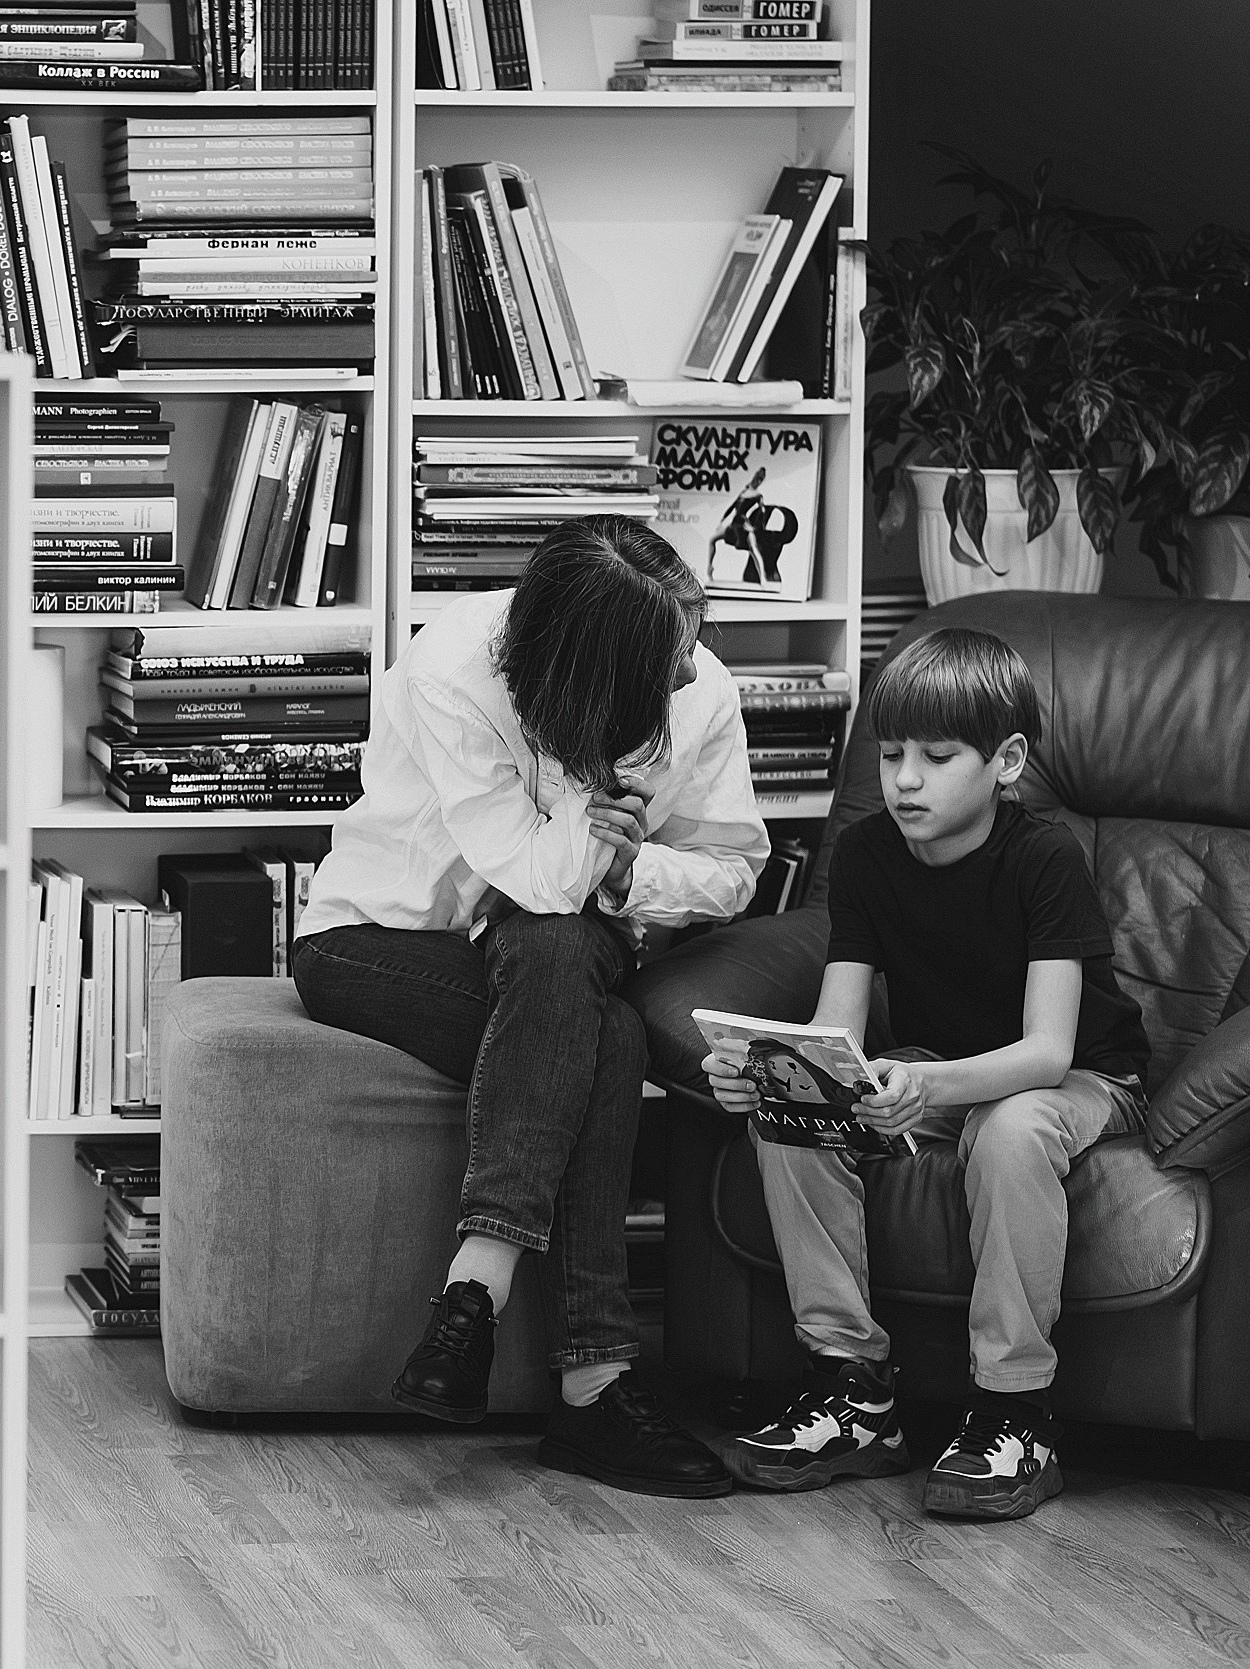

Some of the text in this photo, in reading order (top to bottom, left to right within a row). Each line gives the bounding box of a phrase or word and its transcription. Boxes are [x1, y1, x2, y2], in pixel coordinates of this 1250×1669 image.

[759, 2, 811, 19] ГОМЕР
[10, 23, 97, 35] ЭНЦИКЛОПЕДИЯ
[751, 25, 800, 37] ГОМЕР
[38, 65, 160, 79] Коллаж в России
[18, 246, 32, 292] ПРОМЫСЛЫ
[281, 257, 365, 270] КОНЕНКОВ
[2, 277, 18, 322] DIALOG
[118, 306, 355, 319] ГОСУДАРСТВЕННЫЙ ЭРМИТАЖ
[25, 292, 45, 366] ХУДОЖЕСТВЕННЫЕ
[32, 406, 118, 417] MANN Photographien
[657, 423, 813, 455] СКУЛЬПТУРА
[655, 446, 749, 471] МАЛЫХ
[321, 452, 338, 511] АНТИКВАРИАТ
[656, 468, 730, 492] ФОРМ
[65, 509, 120, 519] творчестве.
[55, 539, 63, 547] и
[64, 539, 120, 550] творчестве.
[97, 576, 176, 586] виктор калинин
[65, 595, 126, 611] БЕЛКИН
[140, 655, 305, 669] СОЮЗ ИСКУССТВА И ТРУДА
[166, 668, 190, 677] труда
[241, 667, 311, 675] изобразительном
[313, 666, 354, 674] искусстве
[177, 702, 242, 712] ЛАДЫЖЕНСКИЙ
[189, 755, 275, 767] ЭММАНУИЛ
[172, 773, 221, 782] ВЛАДИМИР
[222, 773, 267, 781] КОРБАКОВ
[170, 784, 219, 793] ВЛАДИМИР
[145, 793, 341, 807] Владимир КОРБАКОВ графика
[756, 1109, 869, 1133] МАГРИТ
